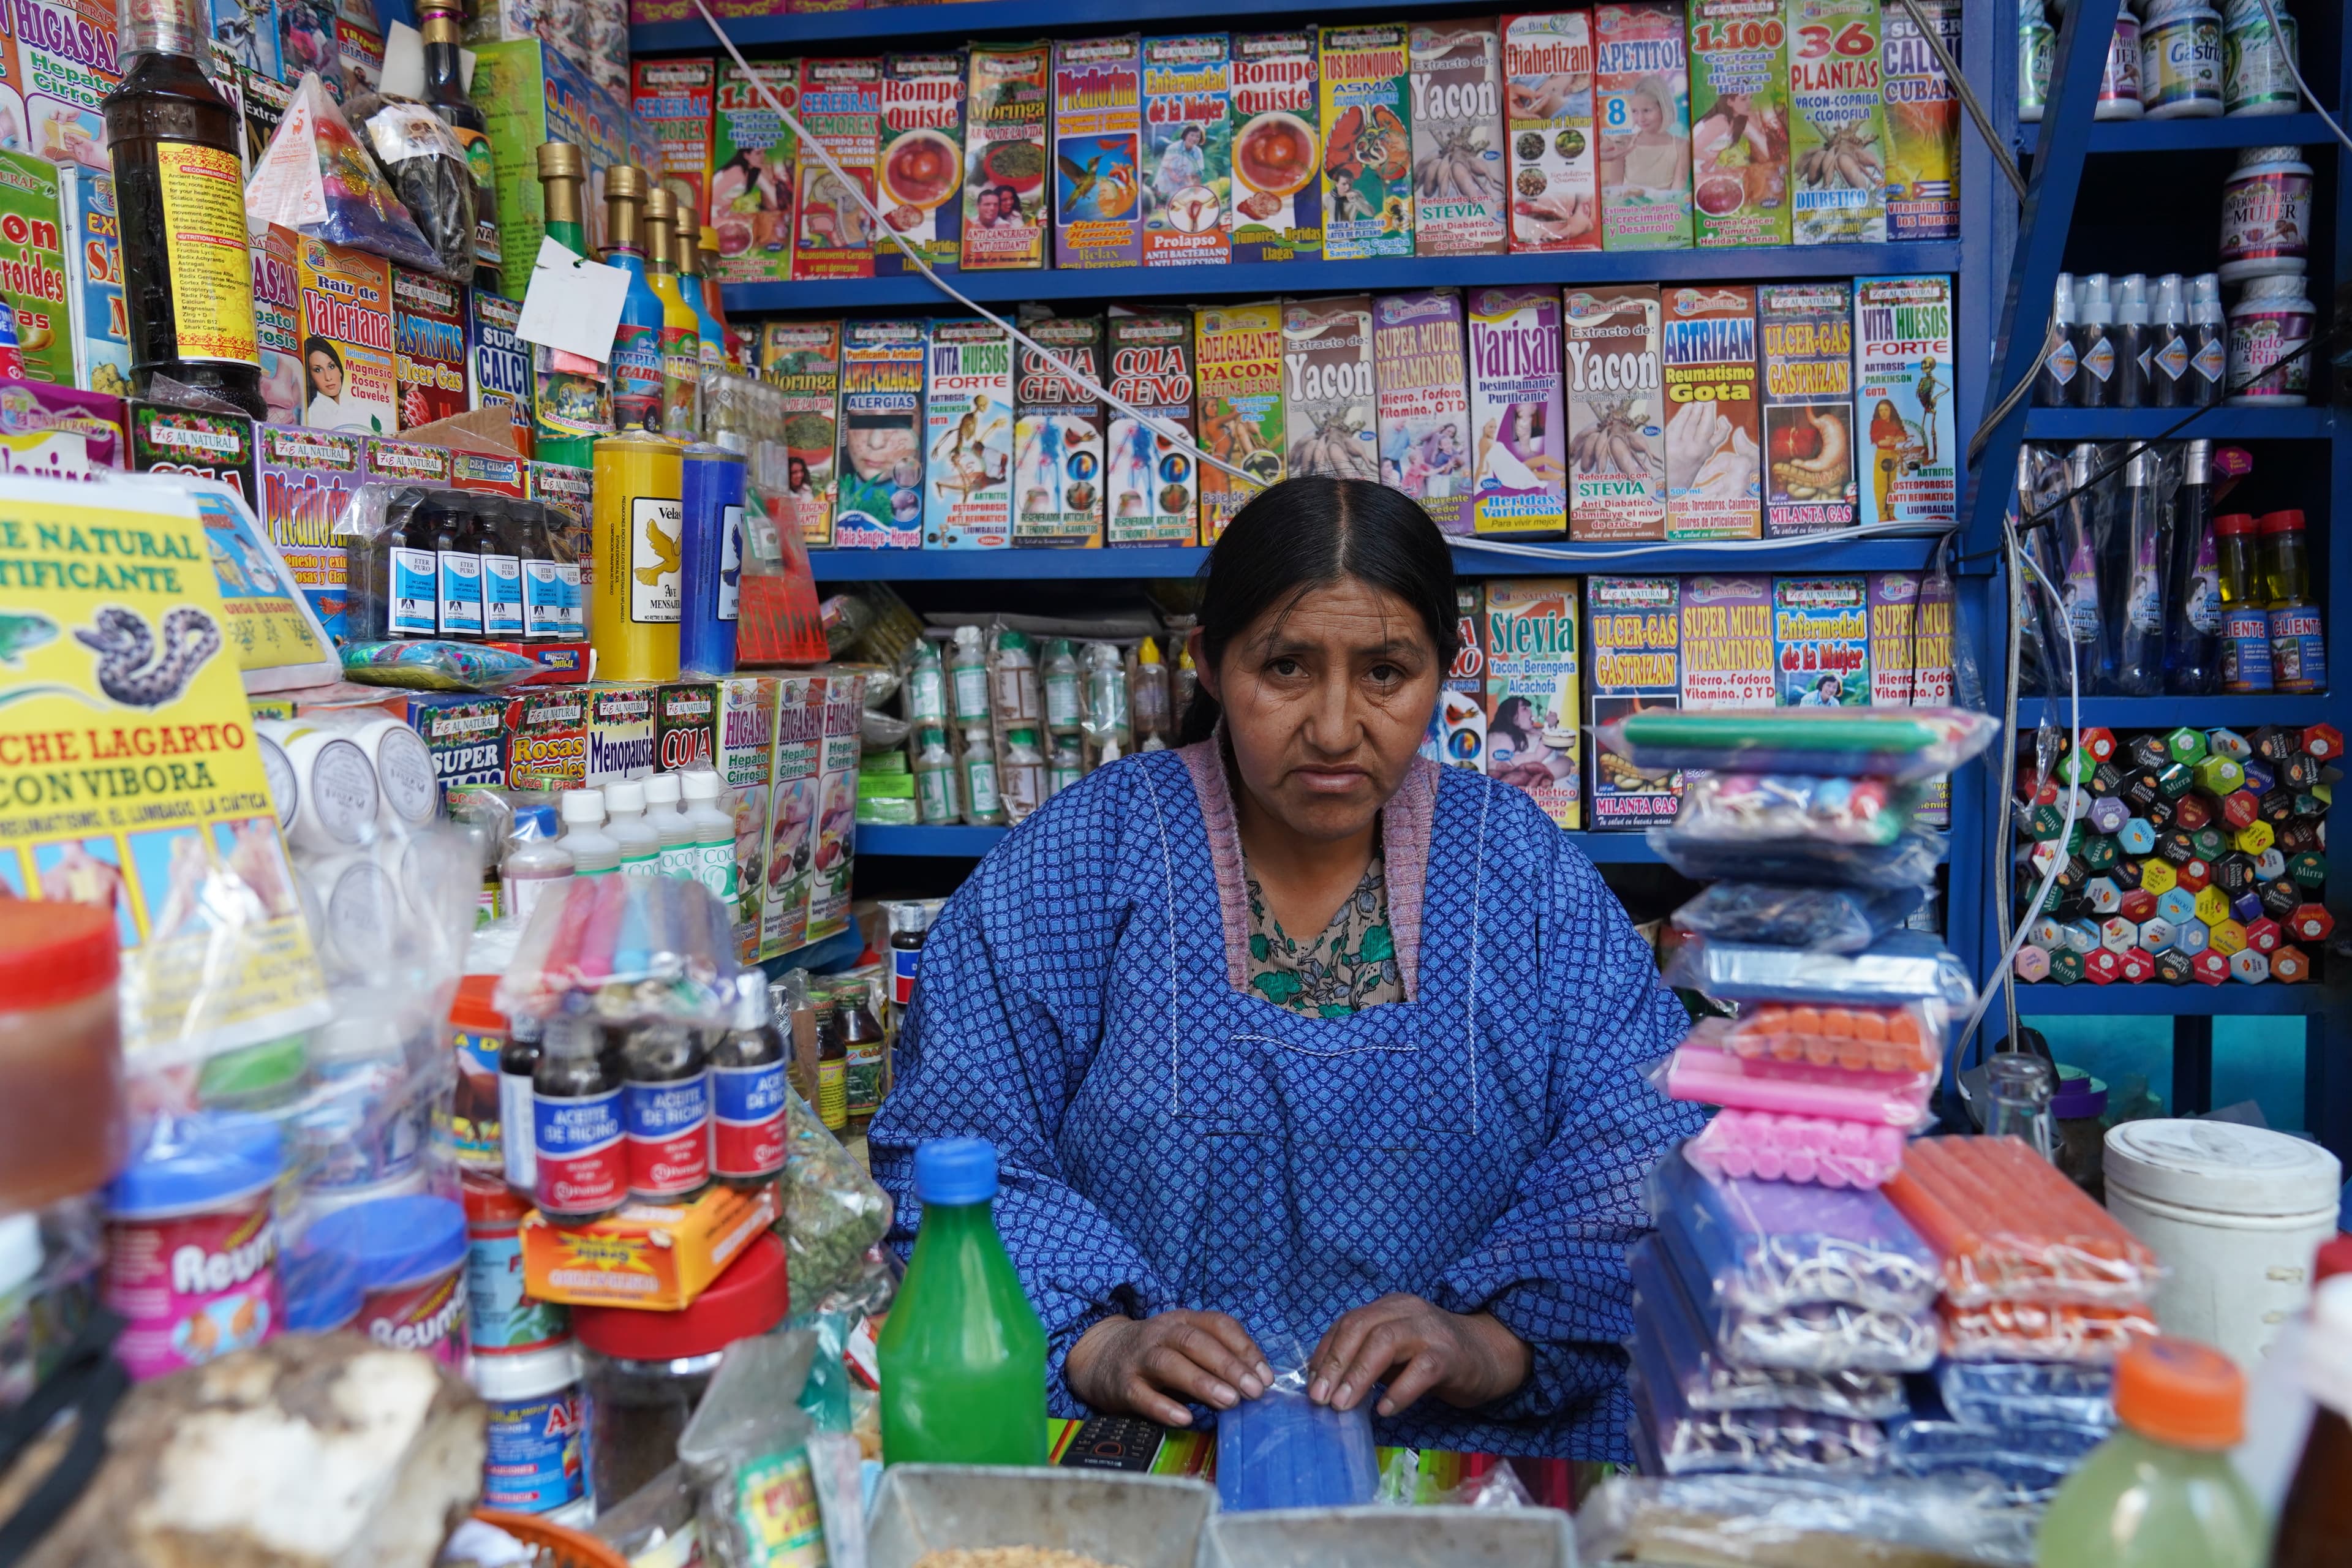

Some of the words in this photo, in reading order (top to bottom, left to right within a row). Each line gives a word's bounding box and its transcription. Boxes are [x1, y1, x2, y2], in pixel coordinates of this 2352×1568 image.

[1694, 23, 1784, 51] 1.100
[1797, 23, 1874, 58] 36
[1324, 55, 1344, 79] TOS
[1347, 52, 1403, 78] BRONQUIOS
[1414, 59, 1468, 71] Extracto
[1509, 43, 1590, 75] Diabetizan
[1599, 39, 1684, 74] APETITOL
[1704, 52, 1774, 63] Cortezas
[1145, 69, 1227, 95] Enfermedad
[1234, 61, 1318, 85] Rompe
[1791, 60, 1878, 91] PLANTAS
[884, 80, 966, 102] Rompe
[1058, 67, 1137, 111] Picaflorina
[1333, 81, 1395, 93] ASMA
[633, 94, 709, 116] CEREBRAL
[801, 92, 880, 113] CEREBRAL
[1238, 89, 1311, 113] Quiste
[1411, 74, 1498, 121] Yacon
[887, 107, 959, 130] Quiste
[970, 99, 1046, 121] Moringa
[1184, 97, 1224, 124] Mujer
[1608, 99, 1626, 125] 8
[183, 166, 227, 178] RECOMMENDED
[1796, 189, 1868, 208] DIURETICO
[1422, 203, 1486, 220] STEVIA
[1616, 213, 1680, 224] crecimiento
[2234, 204, 2296, 225] MUJER
[1619, 222, 1674, 235] Desarrollo
[1704, 217, 1737, 227] Quema
[1155, 235, 1216, 248] Prolapso
[1235, 231, 1275, 244] Tumores
[1080, 249, 1118, 261] Relax
[1171, 248, 1228, 259] BACTERIANO
[317, 275, 353, 296] Raíz
[360, 288, 378, 301] de
[1803, 297, 1836, 306] NATURAL
[304, 290, 391, 351] Valeriana
[1863, 309, 1894, 341] VITA
[1896, 306, 1948, 340] HUESOS
[1376, 325, 1417, 358] SUPER
[1420, 322, 1460, 353] MULTI
[1572, 327, 1632, 338] Extracto
[1664, 320, 1754, 364] ARTRIZAN
[1765, 323, 1850, 356] ULCER-GAS
[1198, 333, 1280, 364] ADELGAZANTE
[1472, 320, 1562, 378] Varisan
[1866, 341, 1948, 356] FORTE
[2231, 333, 2284, 352] Higado
[345, 360, 392, 379] Magnesio
[934, 347, 959, 375] VITA
[963, 345, 1008, 374] HUESOS
[1115, 347, 1186, 375] COLA
[1568, 341, 1658, 391] Yacon
[1864, 363, 1905, 372] ARTROSIS
[396, 356, 434, 385] Ulcer
[437, 365, 462, 391] Gas
[844, 363, 924, 393] ANTI-CHAGAS
[1200, 363, 1279, 380] YACON
[1286, 354, 1374, 401] Yacon
[1376, 353, 1463, 388] VITAMINICO
[1666, 368, 1754, 383] Reumatismo
[1769, 361, 1849, 396] GASTRIZAN
[1865, 374, 1912, 384] PARKINSON
[352, 373, 380, 389] Rosas
[935, 376, 1007, 389] FORTE
[1110, 375, 1192, 405] GENO
[1479, 378, 1556, 392] Desinflamante
[351, 386, 390, 403] Claveles
[1488, 391, 1548, 404] Purificante
[1669, 383, 1750, 402] Gota
[1866, 388, 1887, 397] GOTA
[849, 396, 916, 410] ALERGIAS
[177, 434, 188, 443] AL
[190, 434, 235, 448] NATURAL
[311, 447, 347, 459] NATURAL
[469, 459, 485, 470] DEL
[487, 462, 513, 473] CIELO
[1918, 468, 1953, 477] ARTRITIS
[1579, 482, 1645, 496] STEVIA
[1893, 480, 1953, 490] OSTEOPOROSIS
[1489, 495, 1555, 507] Heridas
[1729, 499, 1758, 510] Calambres
[1909, 493, 1954, 502] REUMATICO
[658, 508, 681, 519] Velas
[1482, 505, 1563, 518] Varicosas
[1572, 510, 1624, 520] Disminuye
[1642, 508, 1663, 516] nivel
[1770, 507, 1825, 524] MILANTA
[1828, 507, 1852, 522] GAS
[1533, 518, 1558, 527] mejor
[1676, 517, 1698, 528] Dolores
[1711, 515, 1752, 527] Articulaciones
[37, 526, 200, 560] NATURAL
[1594, 615, 1678, 648] ULCER-GAS
[1684, 606, 1727, 638] SUPER
[1731, 606, 1772, 637] MULTI
[1779, 613, 1866, 641] Enfermedad
[2273, 619, 2322, 637] CLIENTE
[1490, 612, 1575, 654] Stevia
[1684, 638, 1772, 671] VITAMINICO
[1782, 646, 1800, 671] de
[1819, 643, 1863, 675] Mujer
[1525, 660, 1575, 676] Berengena
[1597, 654, 1676, 688] GASTRIZAN
[1509, 679, 1556, 693] Alcachofa
[452, 723, 460, 731] AL
[462, 717, 496, 730] NATURAL
[88, 722, 244, 760] LAGARTO
[663, 728, 712, 767] COLA
[436, 744, 498, 773] SUPER
[513, 738, 584, 764] Rosas
[591, 726, 654, 777] Menopausia
[729, 752, 769, 767] Hepatol
[85, 763, 217, 800] VIBORA
[728, 768, 768, 783] Cirrosis
[2166, 775, 2190, 793] Mirra
[1596, 798, 1651, 815] MILANTA
[1653, 798, 1677, 813] GAS
[2296, 866, 2323, 879] Mirra
[2052, 960, 2076, 979] Myrrh
[652, 1088, 702, 1109] ACEITE
[554, 1105, 609, 1126] ACEITE
[545, 1124, 567, 1141] DE
[569, 1120, 618, 1138] RICINO
